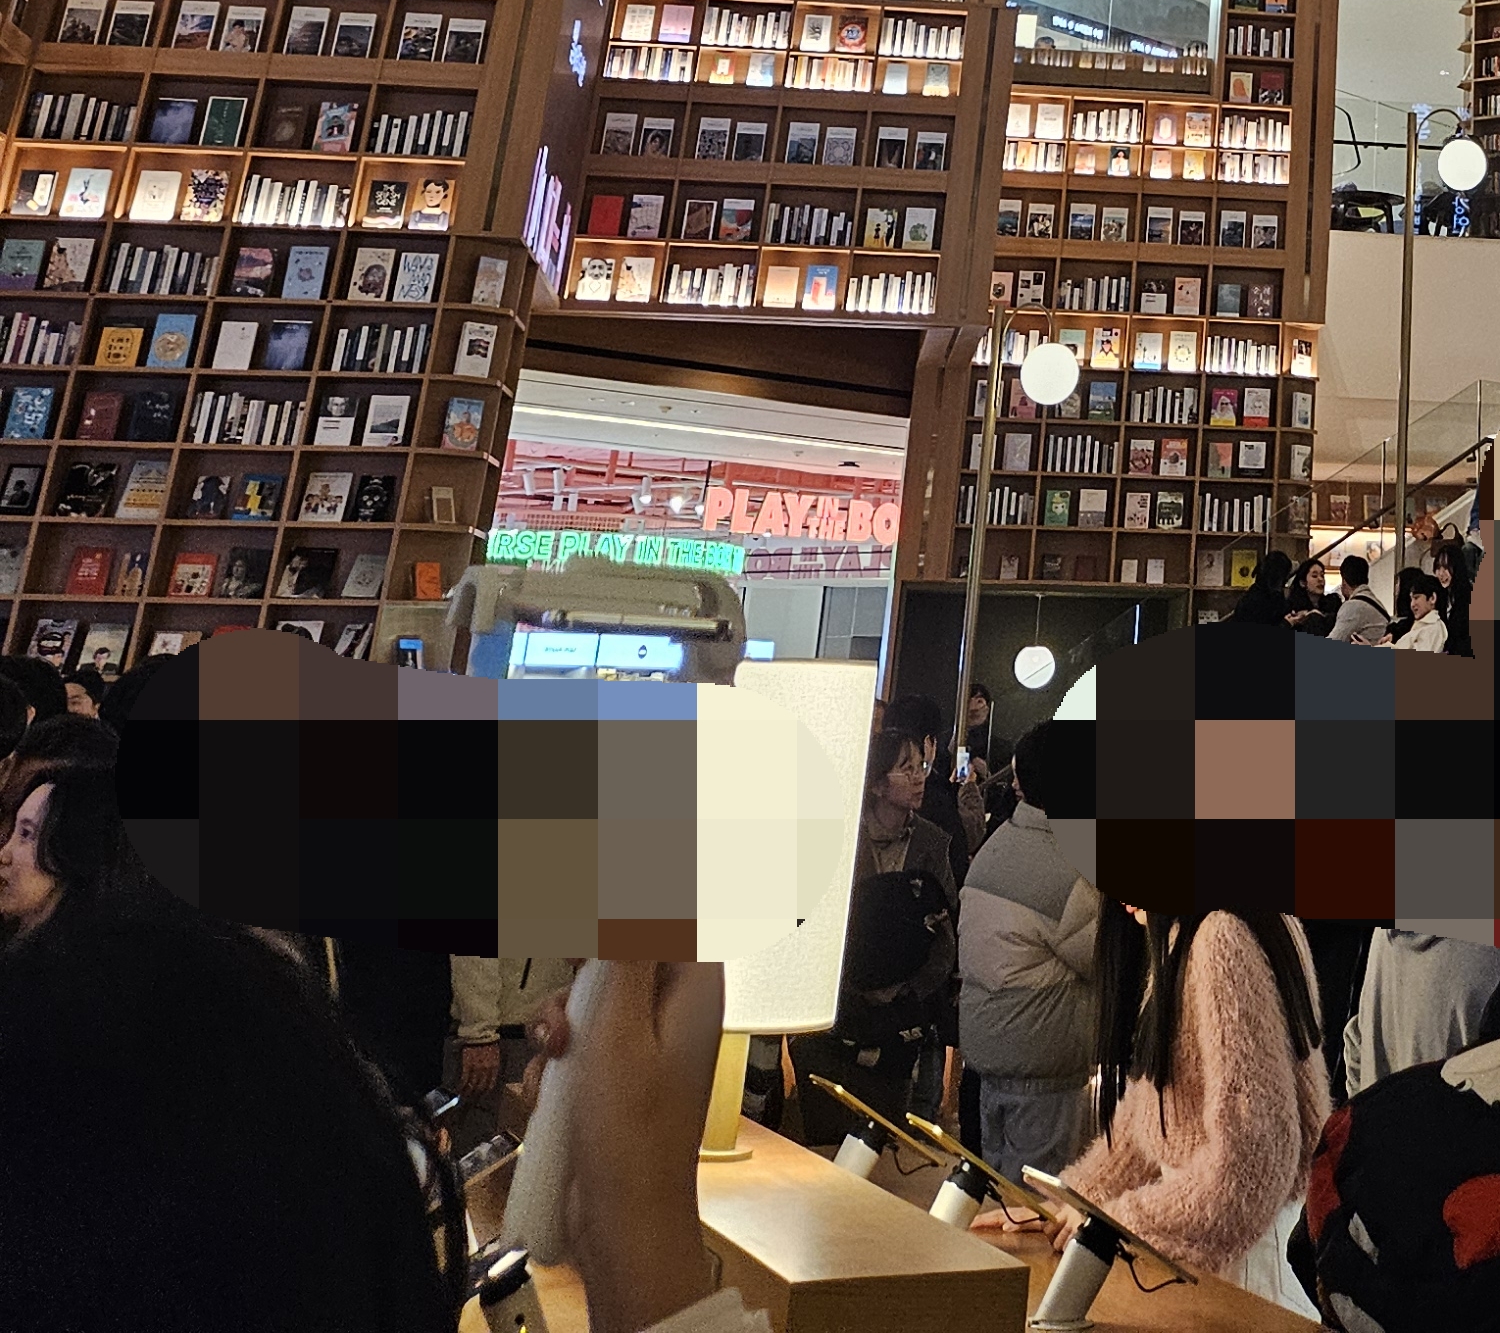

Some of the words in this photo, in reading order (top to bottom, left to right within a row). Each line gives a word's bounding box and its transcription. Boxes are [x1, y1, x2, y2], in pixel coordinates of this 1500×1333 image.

[703, 486, 817, 537] PLAY
[817, 496, 840, 519] IN
[808, 511, 848, 541] THE
[557, 530, 634, 564] PLAY
[634, 535, 665, 565] IN
[666, 538, 705, 569] THE
